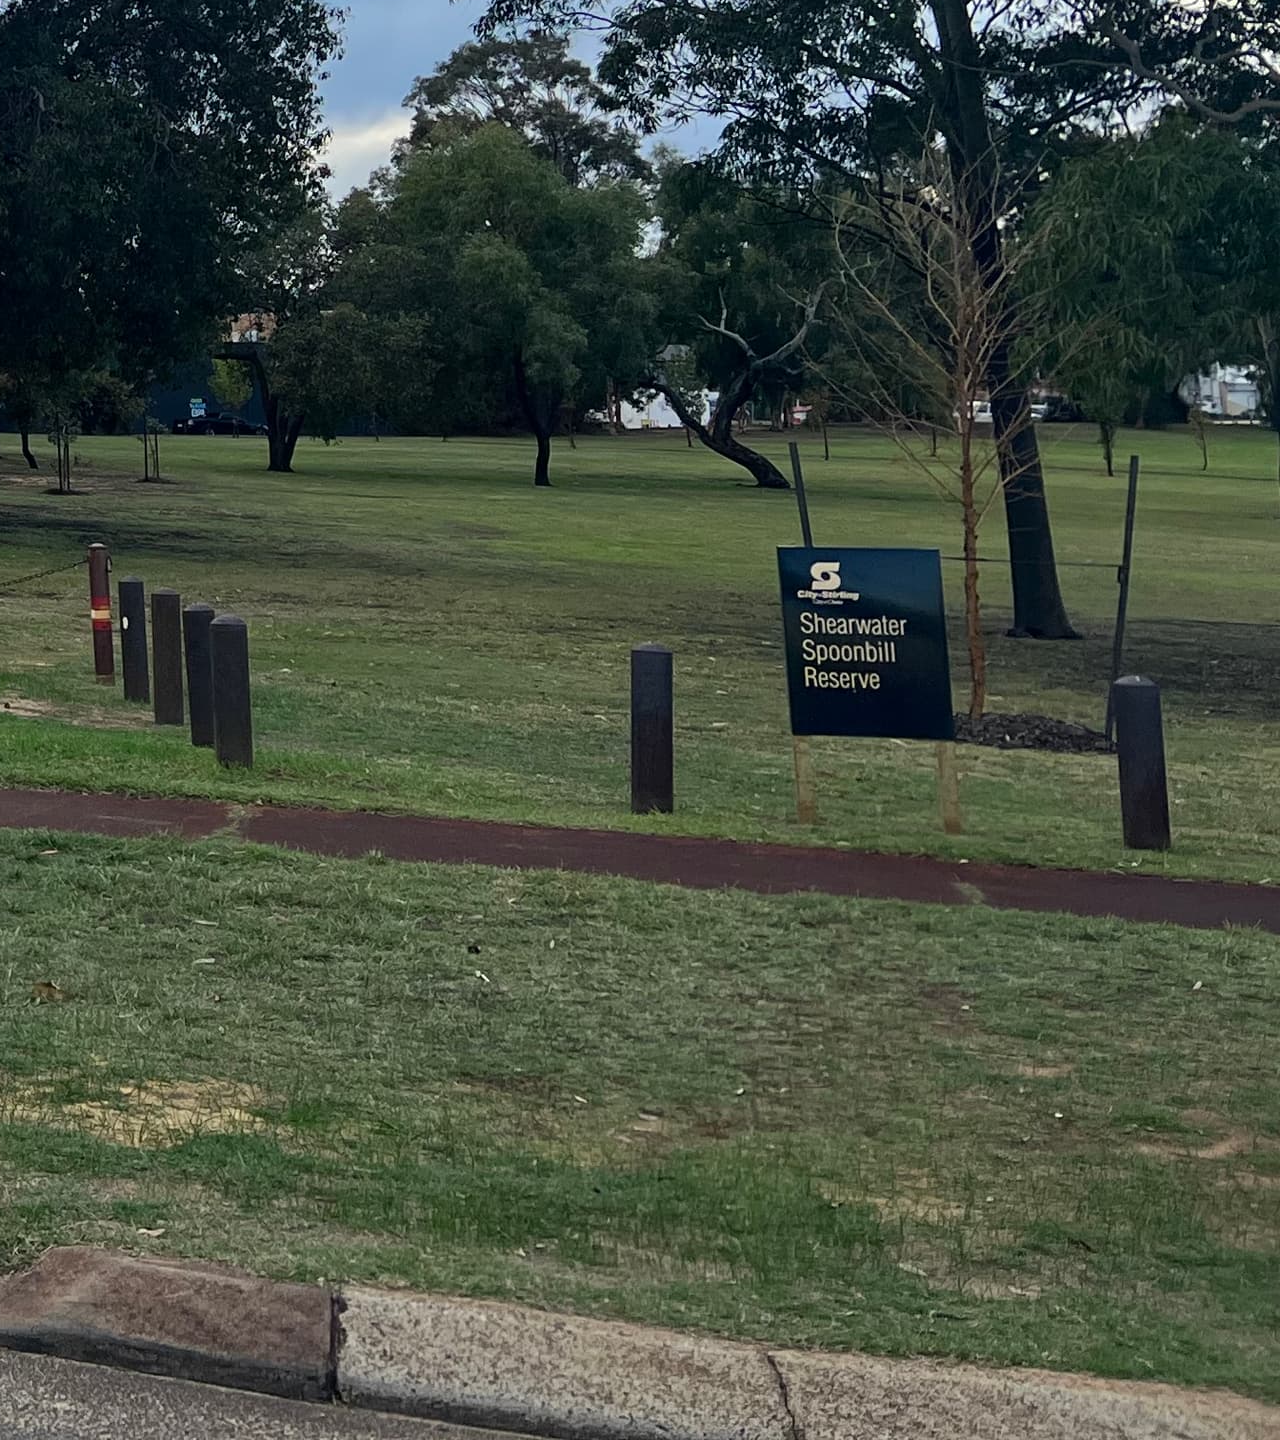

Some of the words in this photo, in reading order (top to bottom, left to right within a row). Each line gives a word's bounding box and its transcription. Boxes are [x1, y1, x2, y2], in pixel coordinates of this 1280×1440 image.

[800, 612, 907, 635] Shearwater
[802, 639, 896, 664] Spoonbill
[804, 666, 881, 689] Reserve
